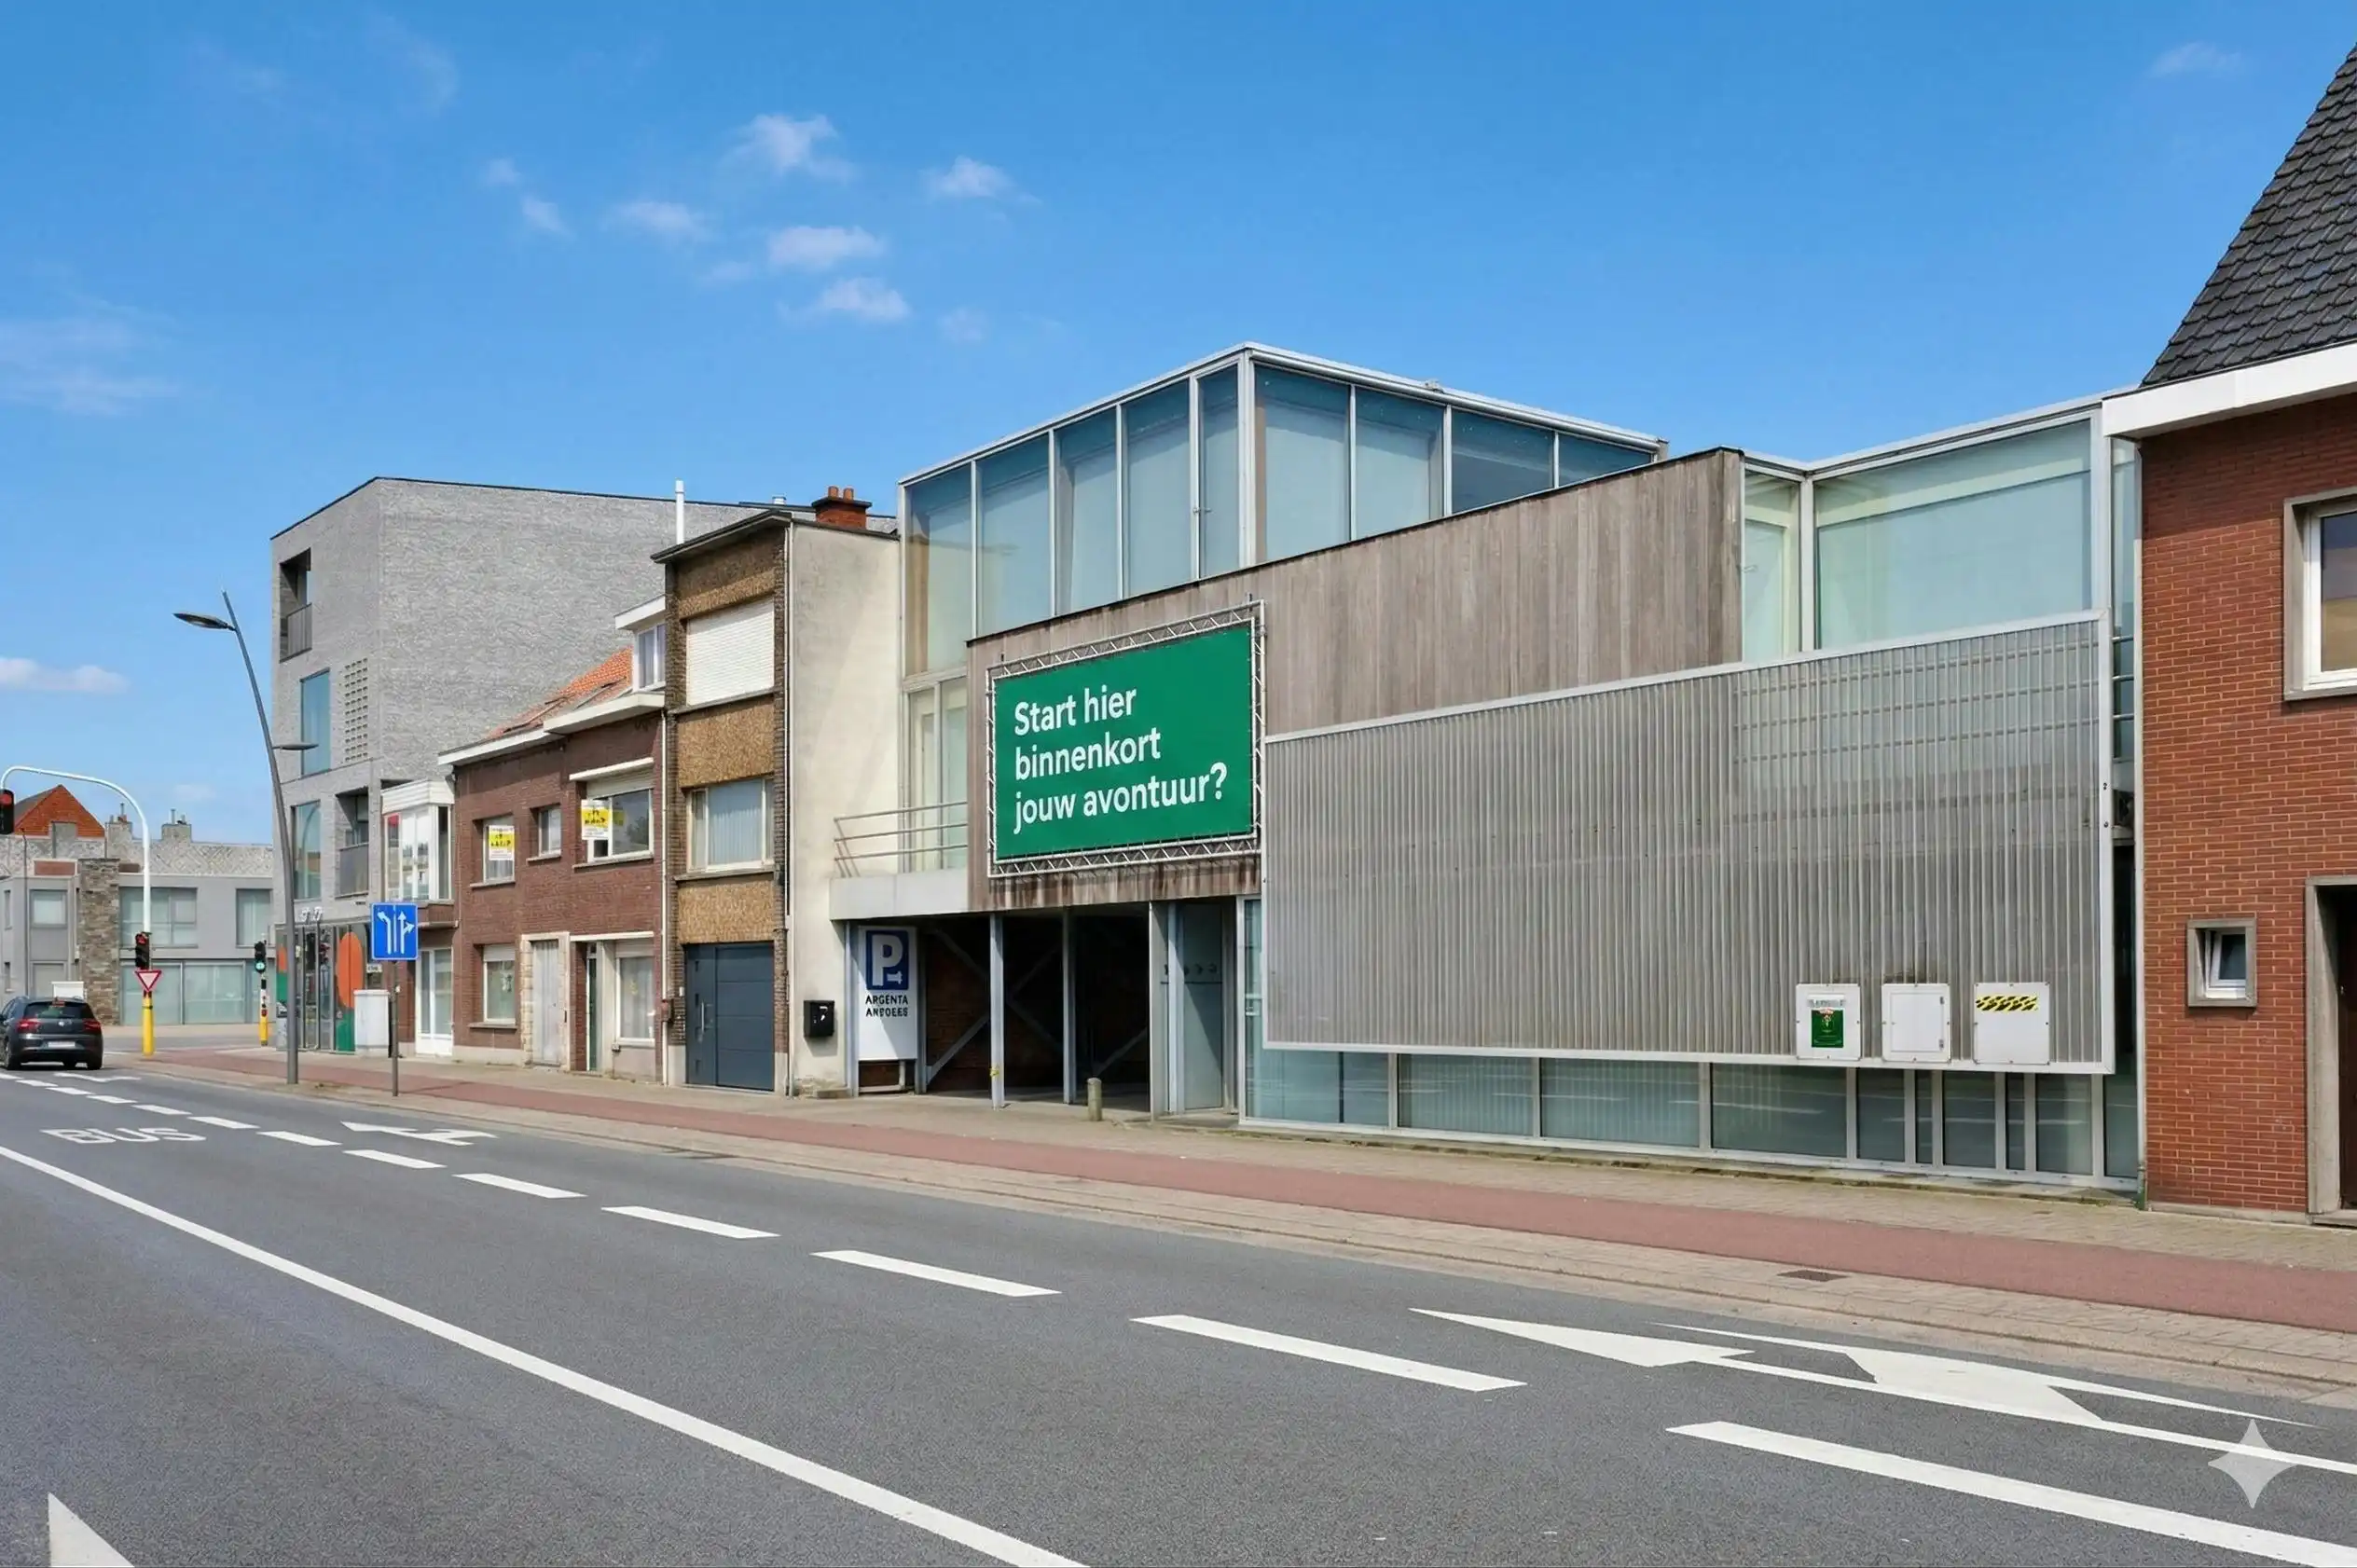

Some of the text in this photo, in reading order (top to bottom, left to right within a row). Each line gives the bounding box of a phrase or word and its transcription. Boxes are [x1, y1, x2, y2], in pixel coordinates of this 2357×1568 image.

[1013, 684, 1137, 736] Start hier
[1014, 727, 1162, 781] binnenkort
[1013, 762, 1228, 835] jouw avontuur?
[865, 995, 908, 1005] ARGENTA
[40, 1128, 207, 1144] BUS
